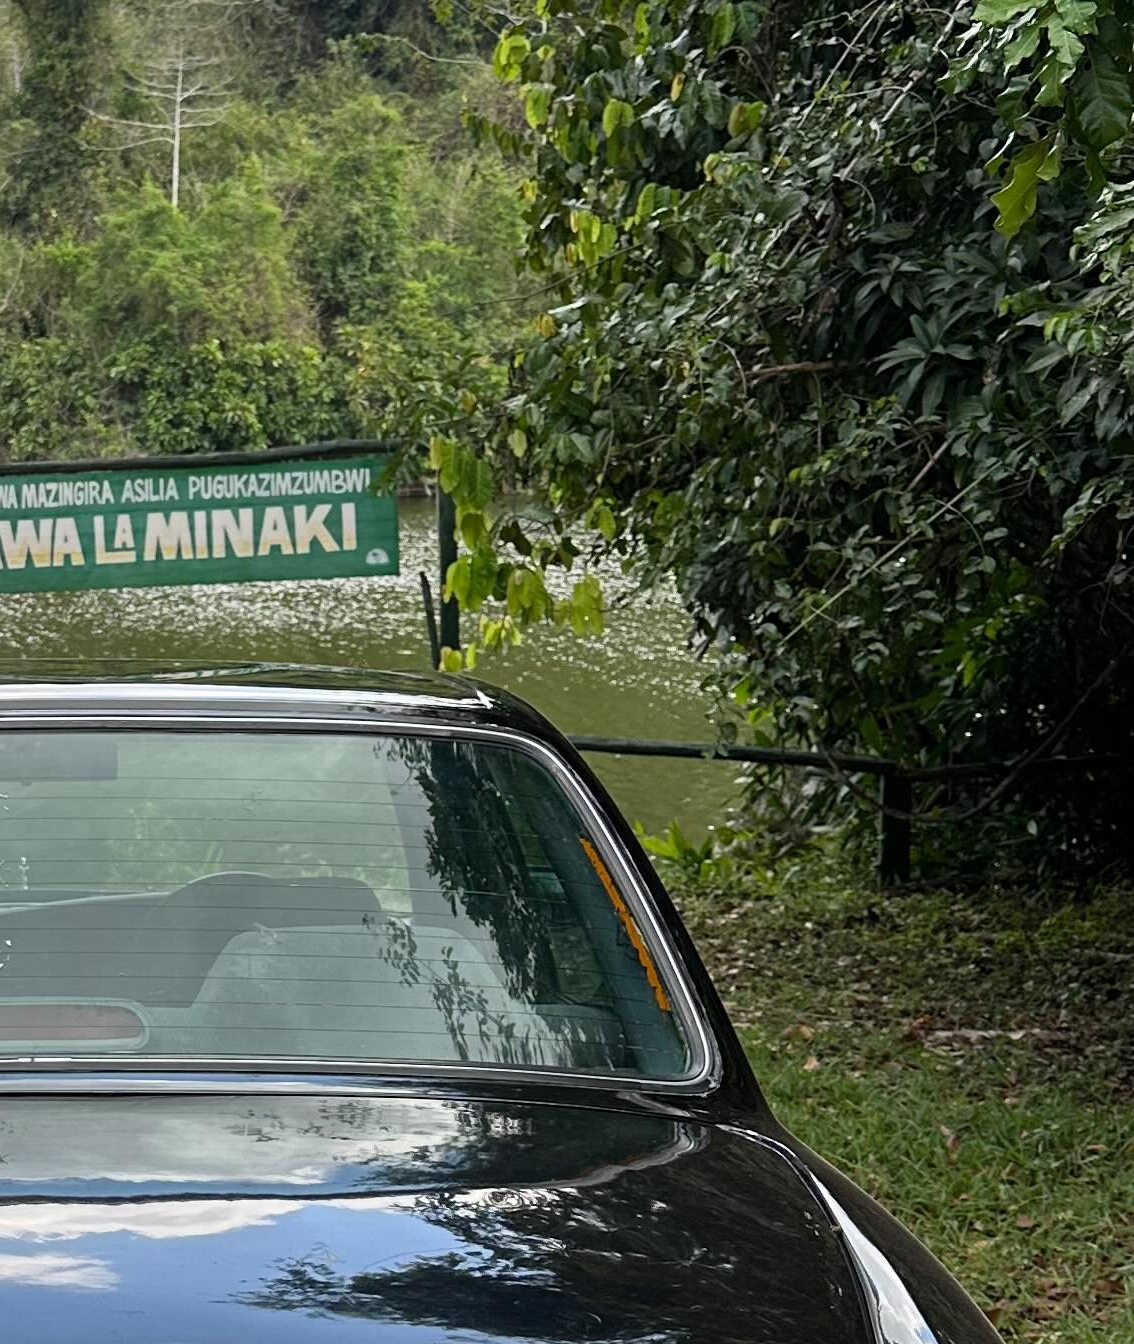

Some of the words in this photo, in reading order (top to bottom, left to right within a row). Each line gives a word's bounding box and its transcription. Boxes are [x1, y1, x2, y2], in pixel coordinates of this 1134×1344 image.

[21, 480, 115, 509] MAZINGIRA
[121, 477, 178, 504] ASILIA
[188, 467, 371, 501] PUGUKAZIMZUMBWI
[93, 513, 137, 565] LA
[143, 502, 358, 562] MINAKI
